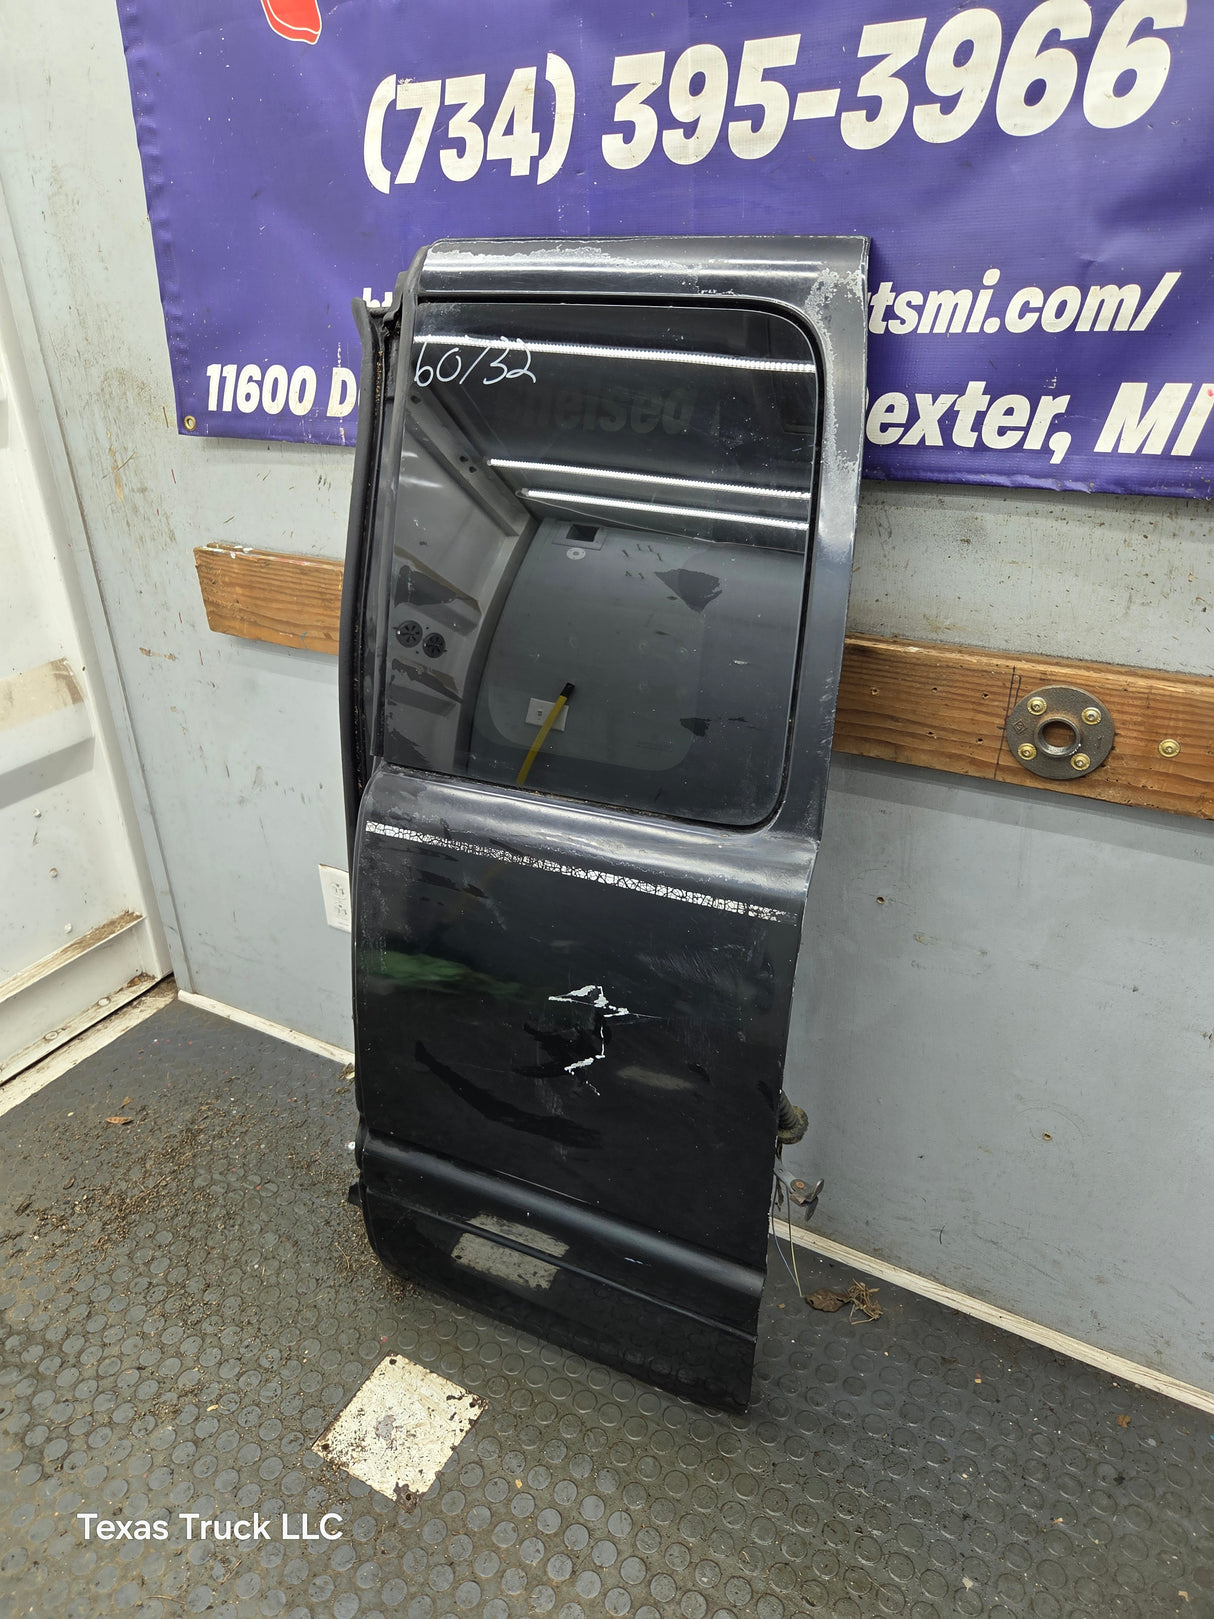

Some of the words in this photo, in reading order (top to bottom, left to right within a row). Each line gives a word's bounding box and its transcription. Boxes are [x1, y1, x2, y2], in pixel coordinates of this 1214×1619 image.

[363, 53, 576, 194] (734)
[601, 0, 1188, 170] 395-3966
[866, 268, 1182, 336] tsmi.com/
[206, 363, 318, 416] 11600
[865, 381, 1072, 464] exter,
[1094, 382, 1214, 457] MI
